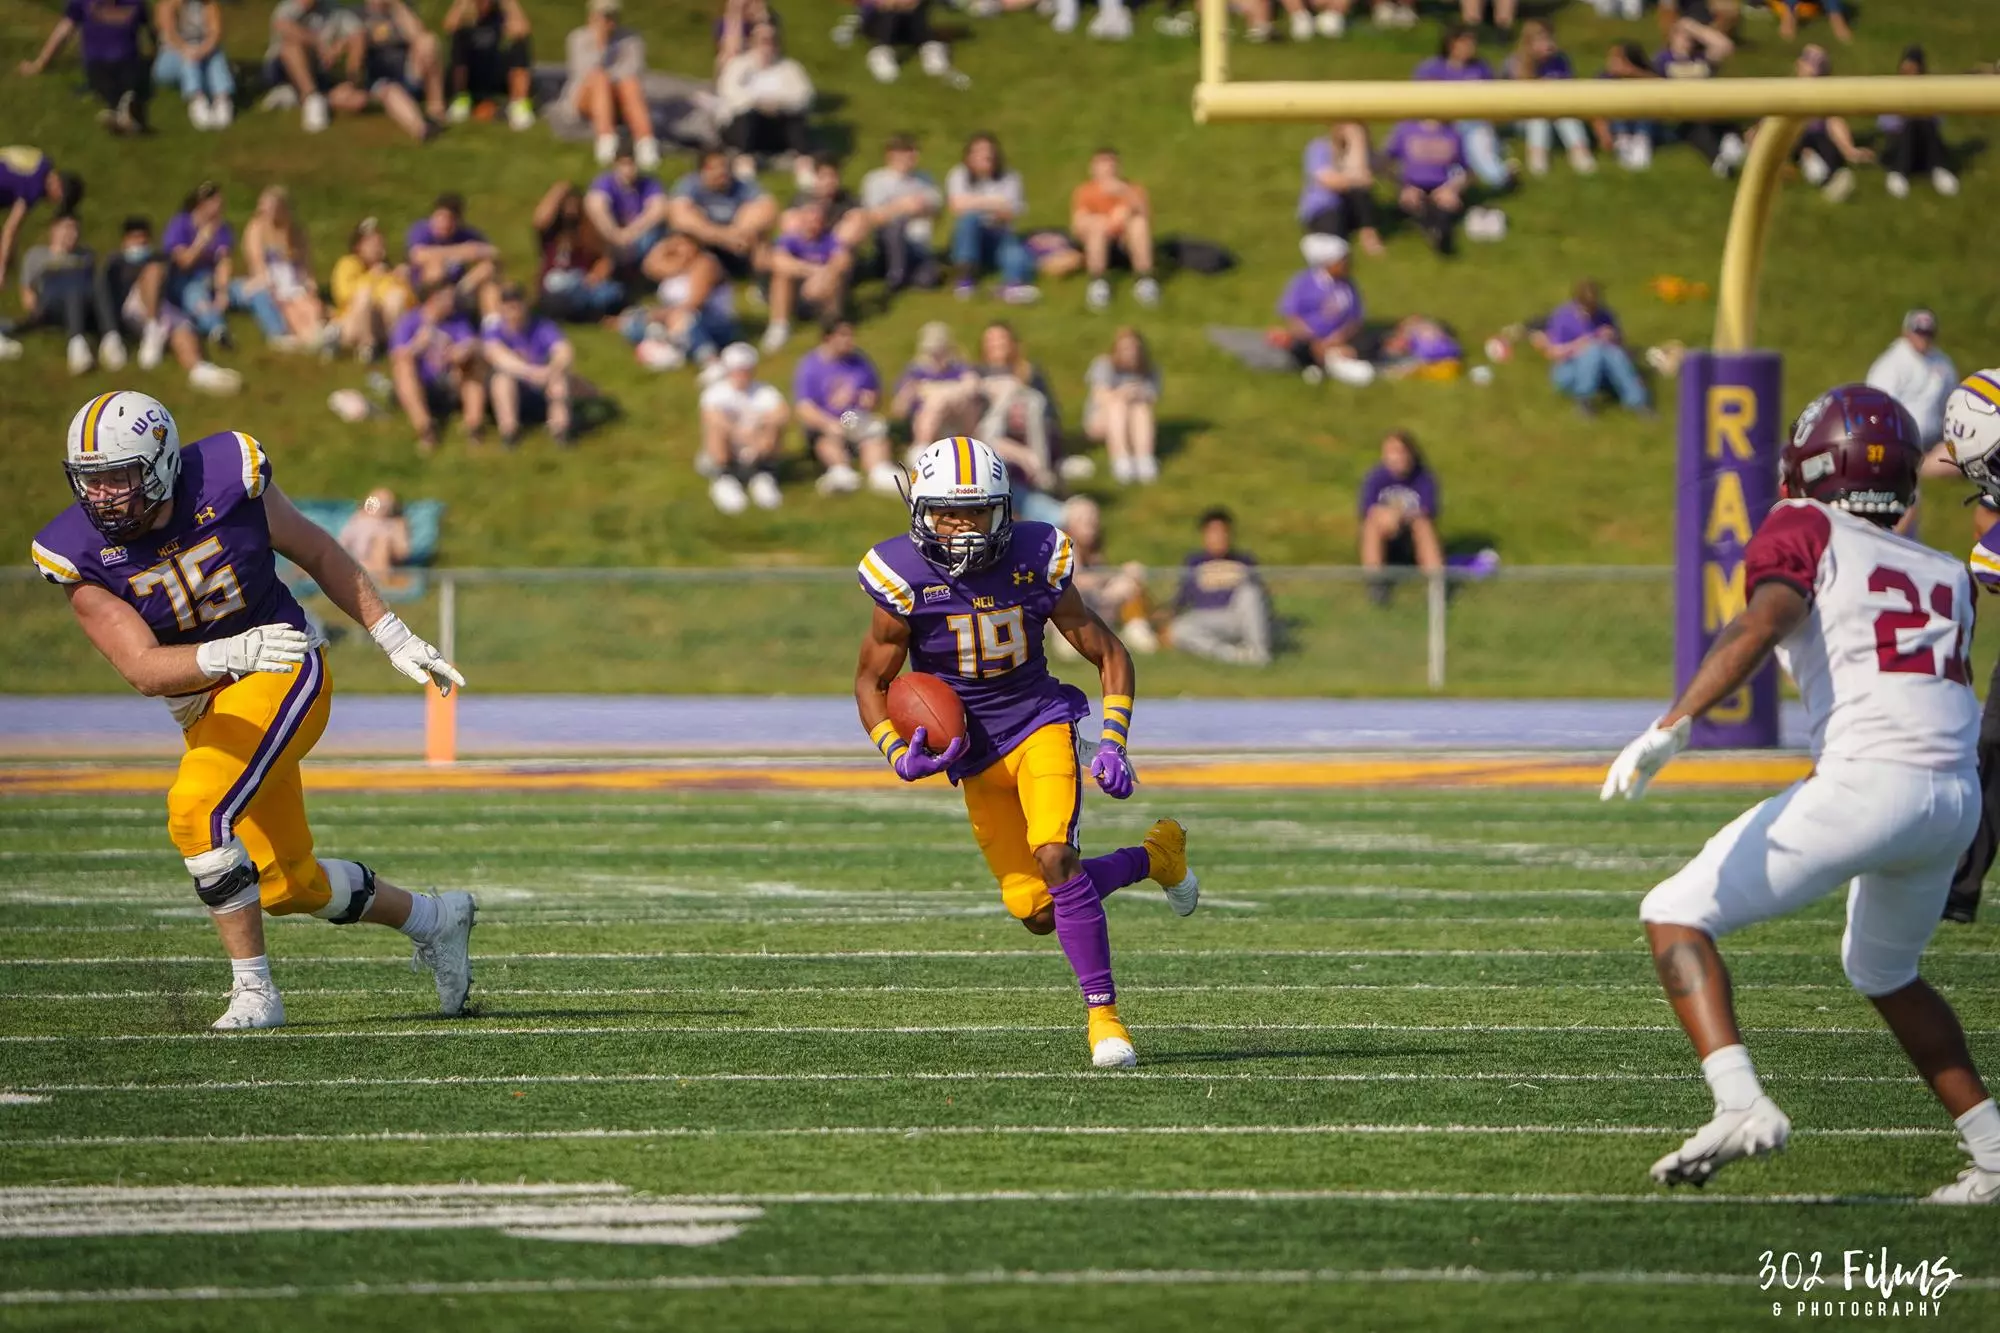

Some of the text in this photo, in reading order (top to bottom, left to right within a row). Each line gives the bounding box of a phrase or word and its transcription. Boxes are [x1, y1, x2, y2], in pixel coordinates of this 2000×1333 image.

[131, 409, 170, 436] WCU
[102, 549, 128, 561] PSAC
[128, 535, 247, 632] 75
[925, 588, 950, 600] PSAC
[972, 596, 994, 609] WCU
[1867, 565, 1968, 687] 21
[946, 604, 1028, 678] 19
